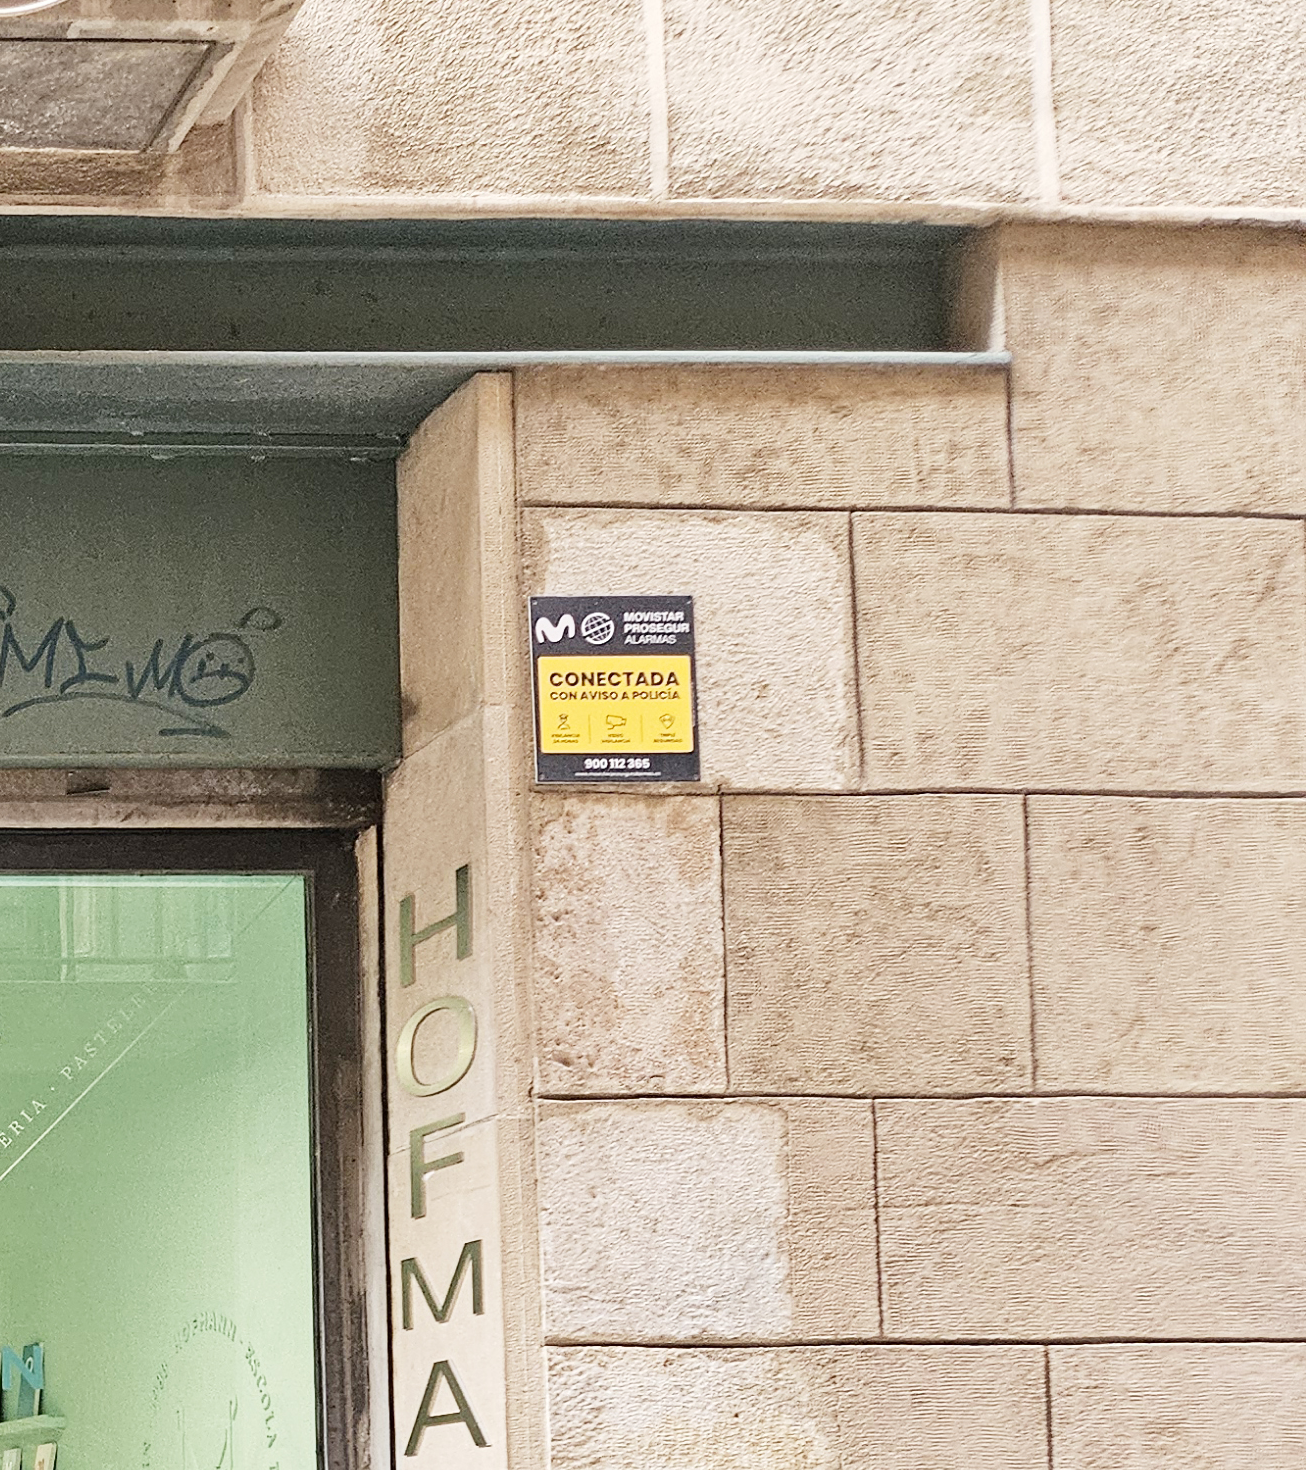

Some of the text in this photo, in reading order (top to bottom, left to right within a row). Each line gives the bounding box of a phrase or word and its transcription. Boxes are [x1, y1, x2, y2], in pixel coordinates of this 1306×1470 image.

[623, 611, 685, 622] MOVISTAR
[623, 622, 690, 634] PROSEGUR
[624, 634, 677, 645] ALARMAS
[549, 671, 680, 687] CONECTADA
[550, 688, 680, 700] CON AVISO A POLICÍA
[584, 758, 651, 769] 900 112 365
